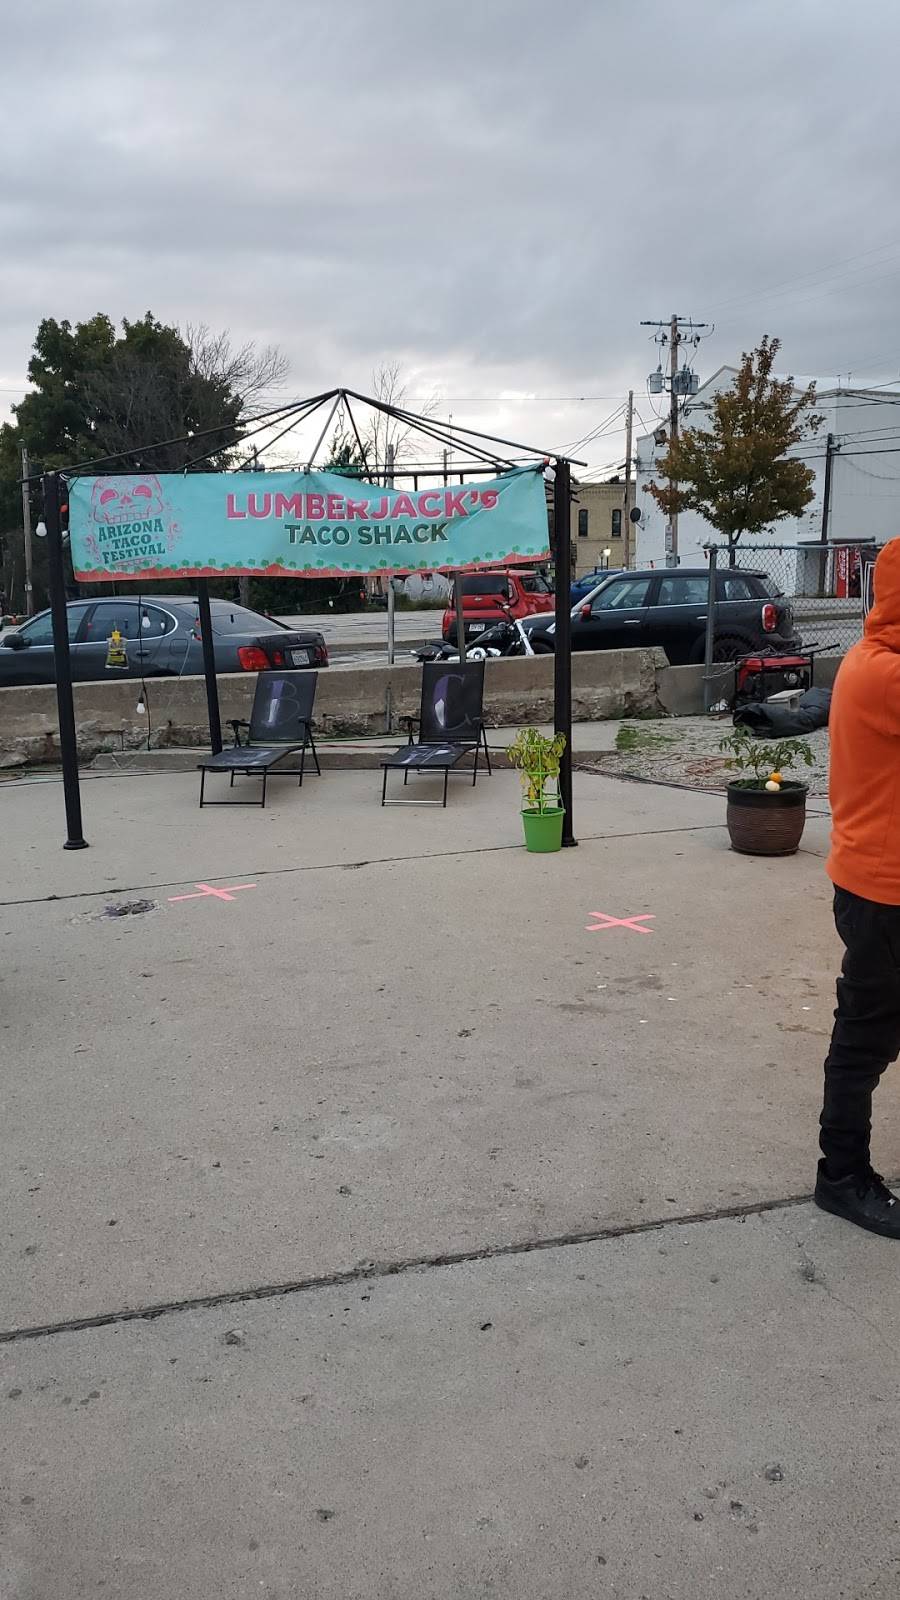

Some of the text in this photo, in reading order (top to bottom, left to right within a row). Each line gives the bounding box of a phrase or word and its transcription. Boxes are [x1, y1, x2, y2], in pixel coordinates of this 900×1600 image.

[226, 489, 499, 520] LUMBERJACK'S
[98, 518, 164, 542] ARIZONA
[284, 523, 448, 546] TACO SHACK
[102, 542, 166, 564] FESTIVAL
[111, 534, 152, 550] TACO
